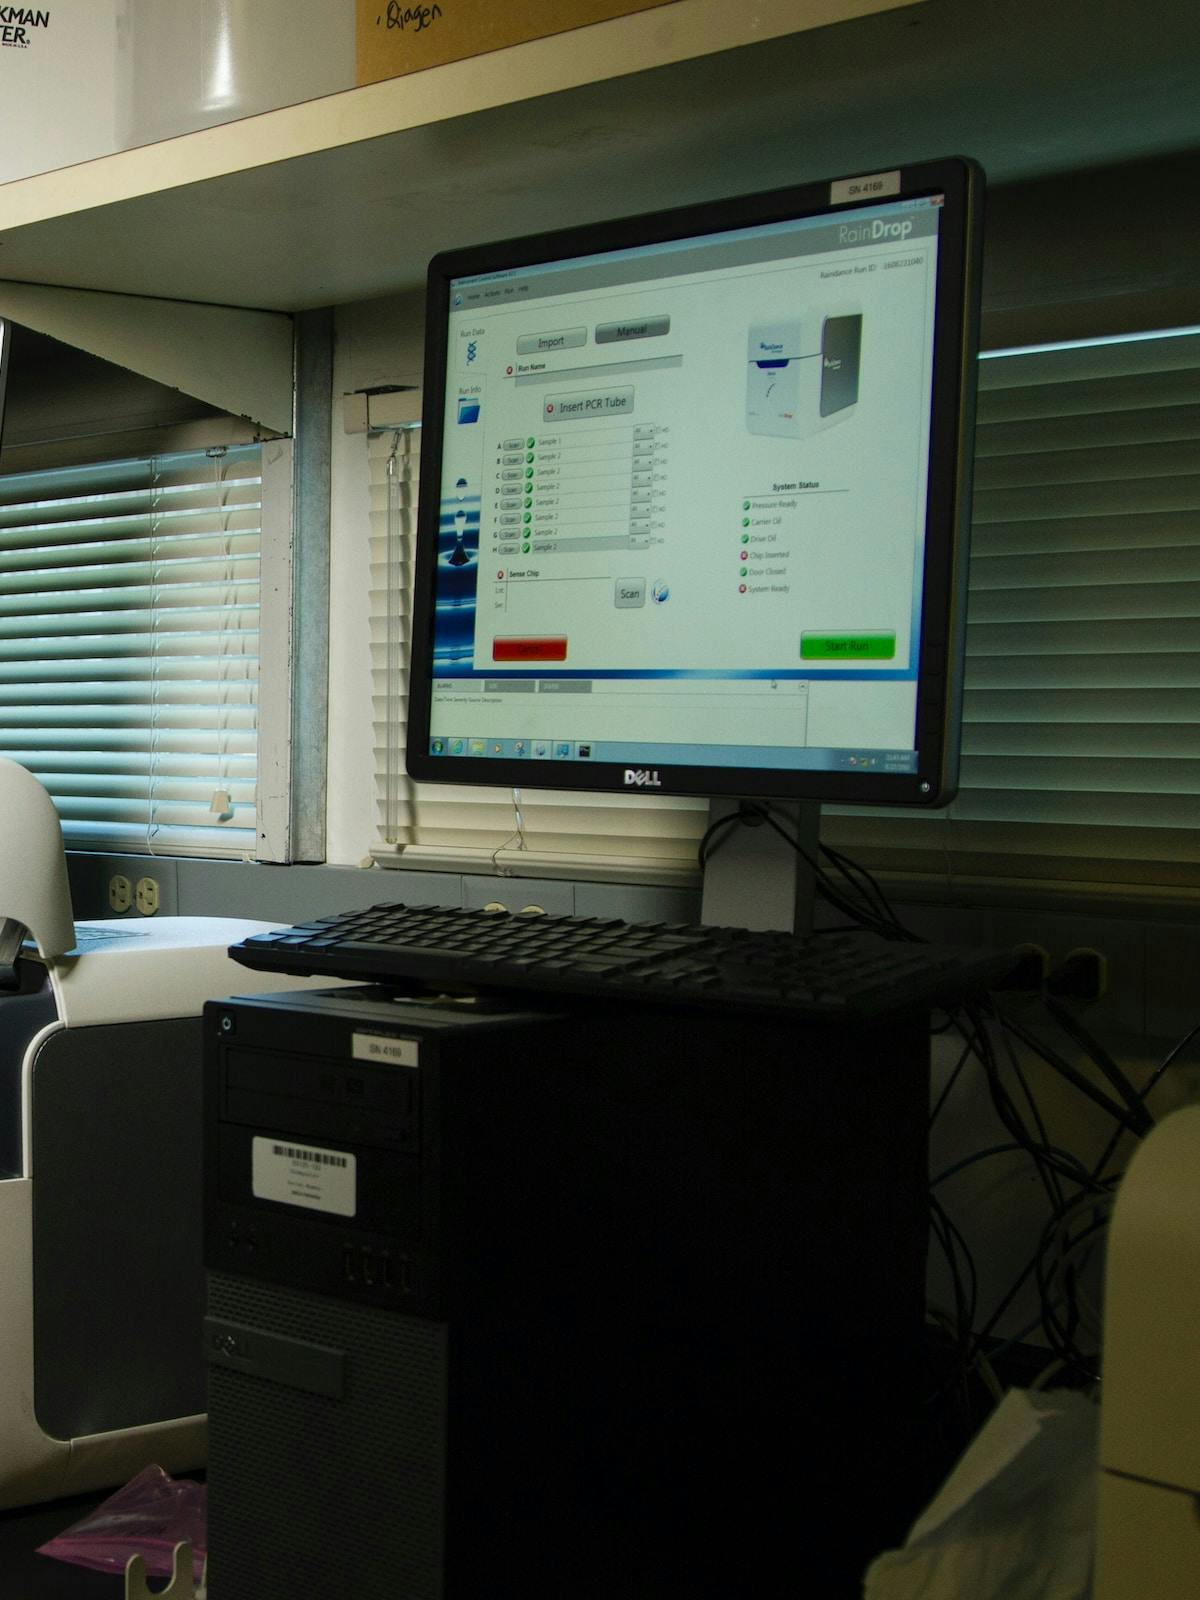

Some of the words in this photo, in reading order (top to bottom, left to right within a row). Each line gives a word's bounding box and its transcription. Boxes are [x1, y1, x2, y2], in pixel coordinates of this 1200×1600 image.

[848, 184, 861, 195] SN
[863, 181, 883, 192] 4169
[839, 219, 913, 243] RainDrop
[616, 323, 647, 337] Manual
[538, 337, 564, 349] Import
[530, 362, 546, 371] Name
[560, 401, 584, 414] Insert
[586, 398, 603, 411] PCR
[605, 396, 627, 409] Tube
[773, 483, 796, 492] System
[799, 481, 820, 489] Status
[526, 570, 540, 578] Chip
[620, 588, 640, 600] Scan
[825, 640, 847, 652] Start
[849, 640, 869, 651] Run
[624, 769, 662, 786] DELL
